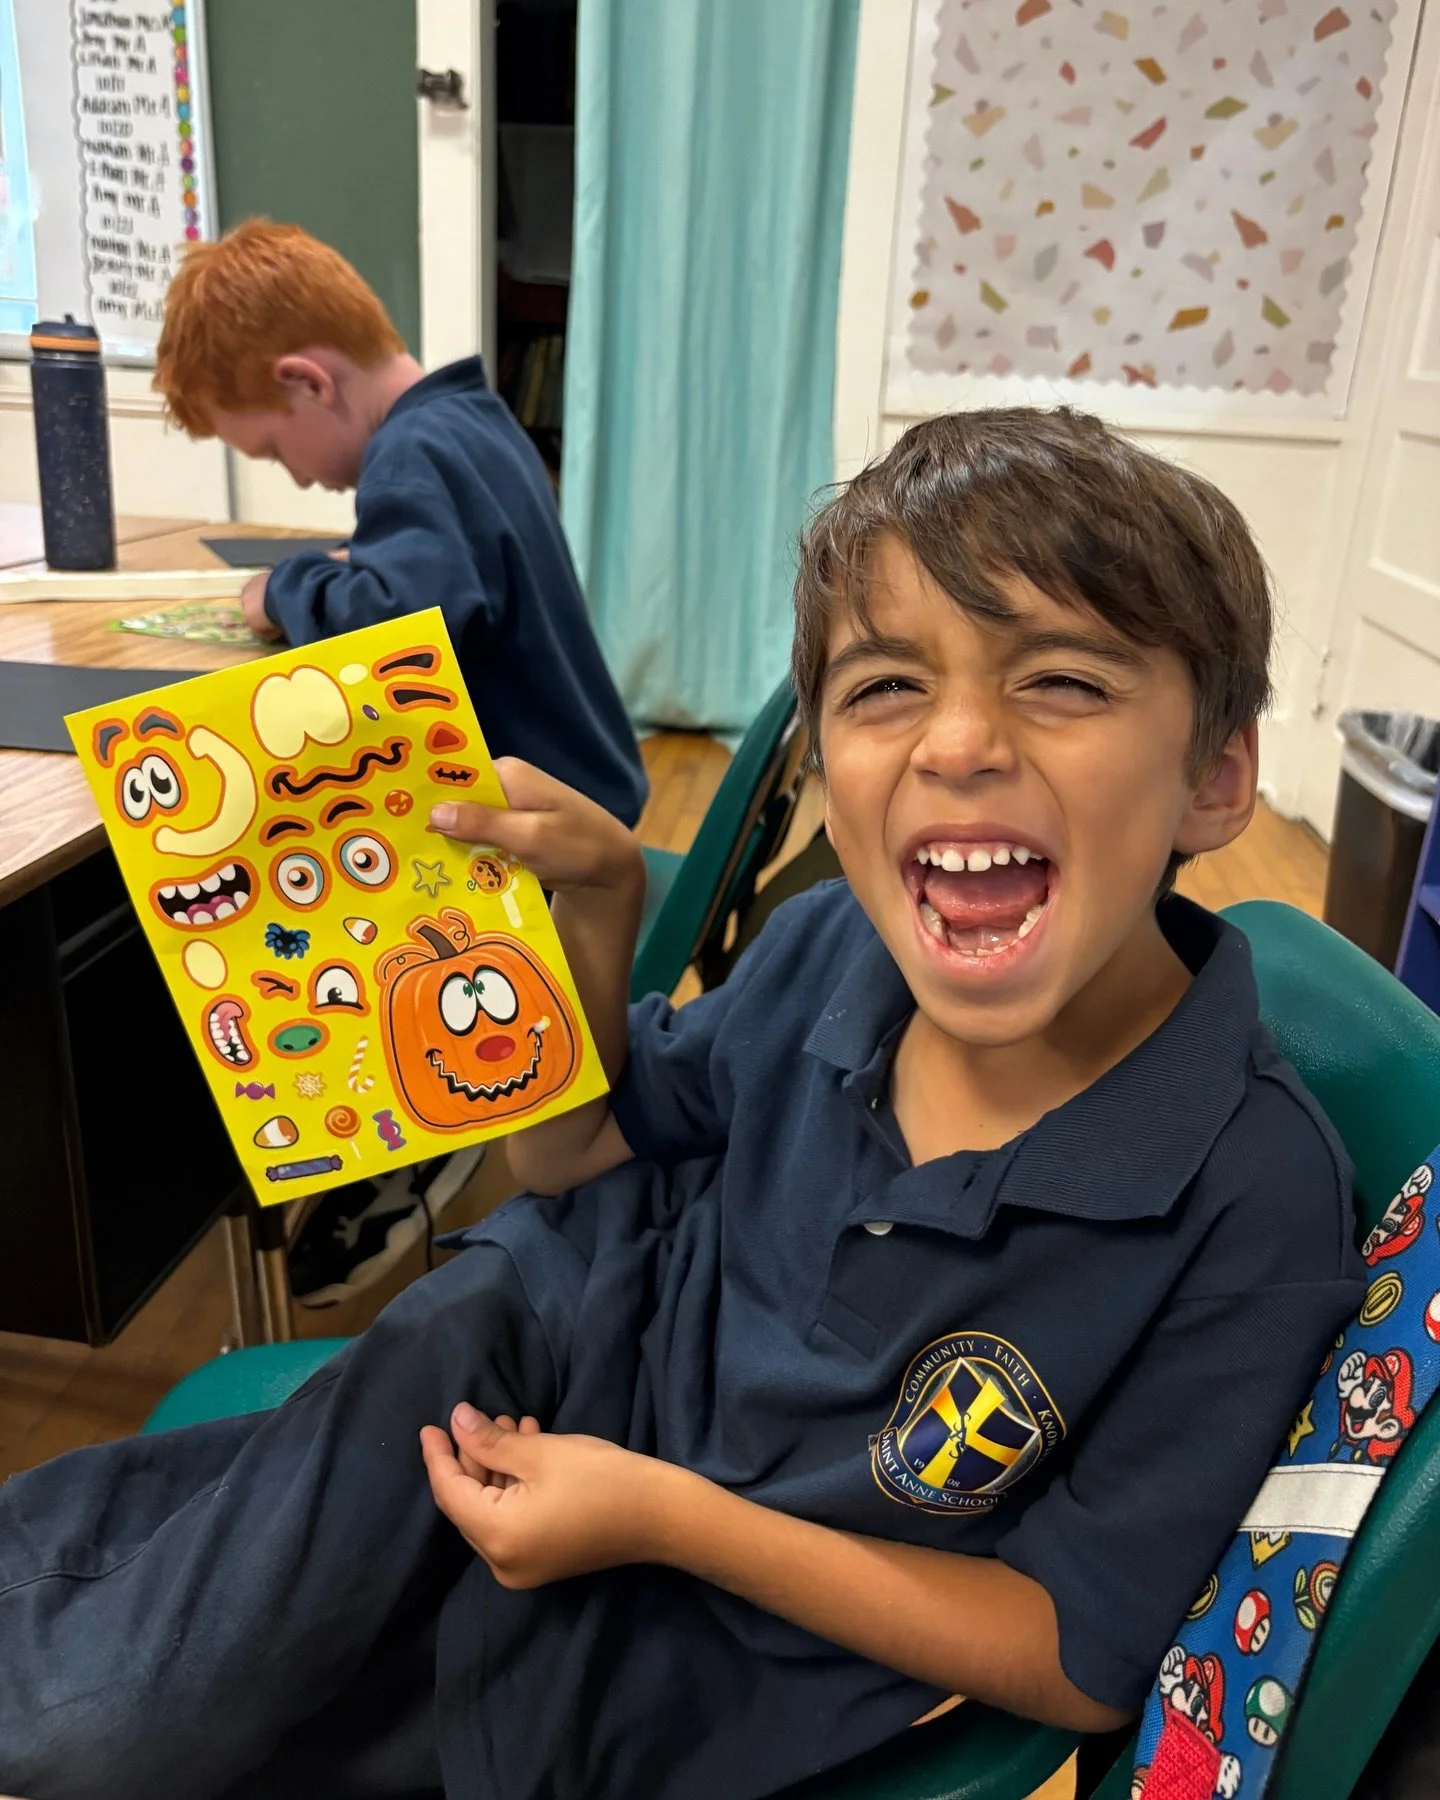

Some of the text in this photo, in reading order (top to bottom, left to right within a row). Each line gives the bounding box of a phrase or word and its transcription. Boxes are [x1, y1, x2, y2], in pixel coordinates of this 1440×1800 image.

[905, 1340, 975, 1403] COMMUNITY
[995, 1345, 1030, 1387] FAITH
[881, 1431, 899, 1472] SAINT
[894, 1472, 936, 1499] ANNE
